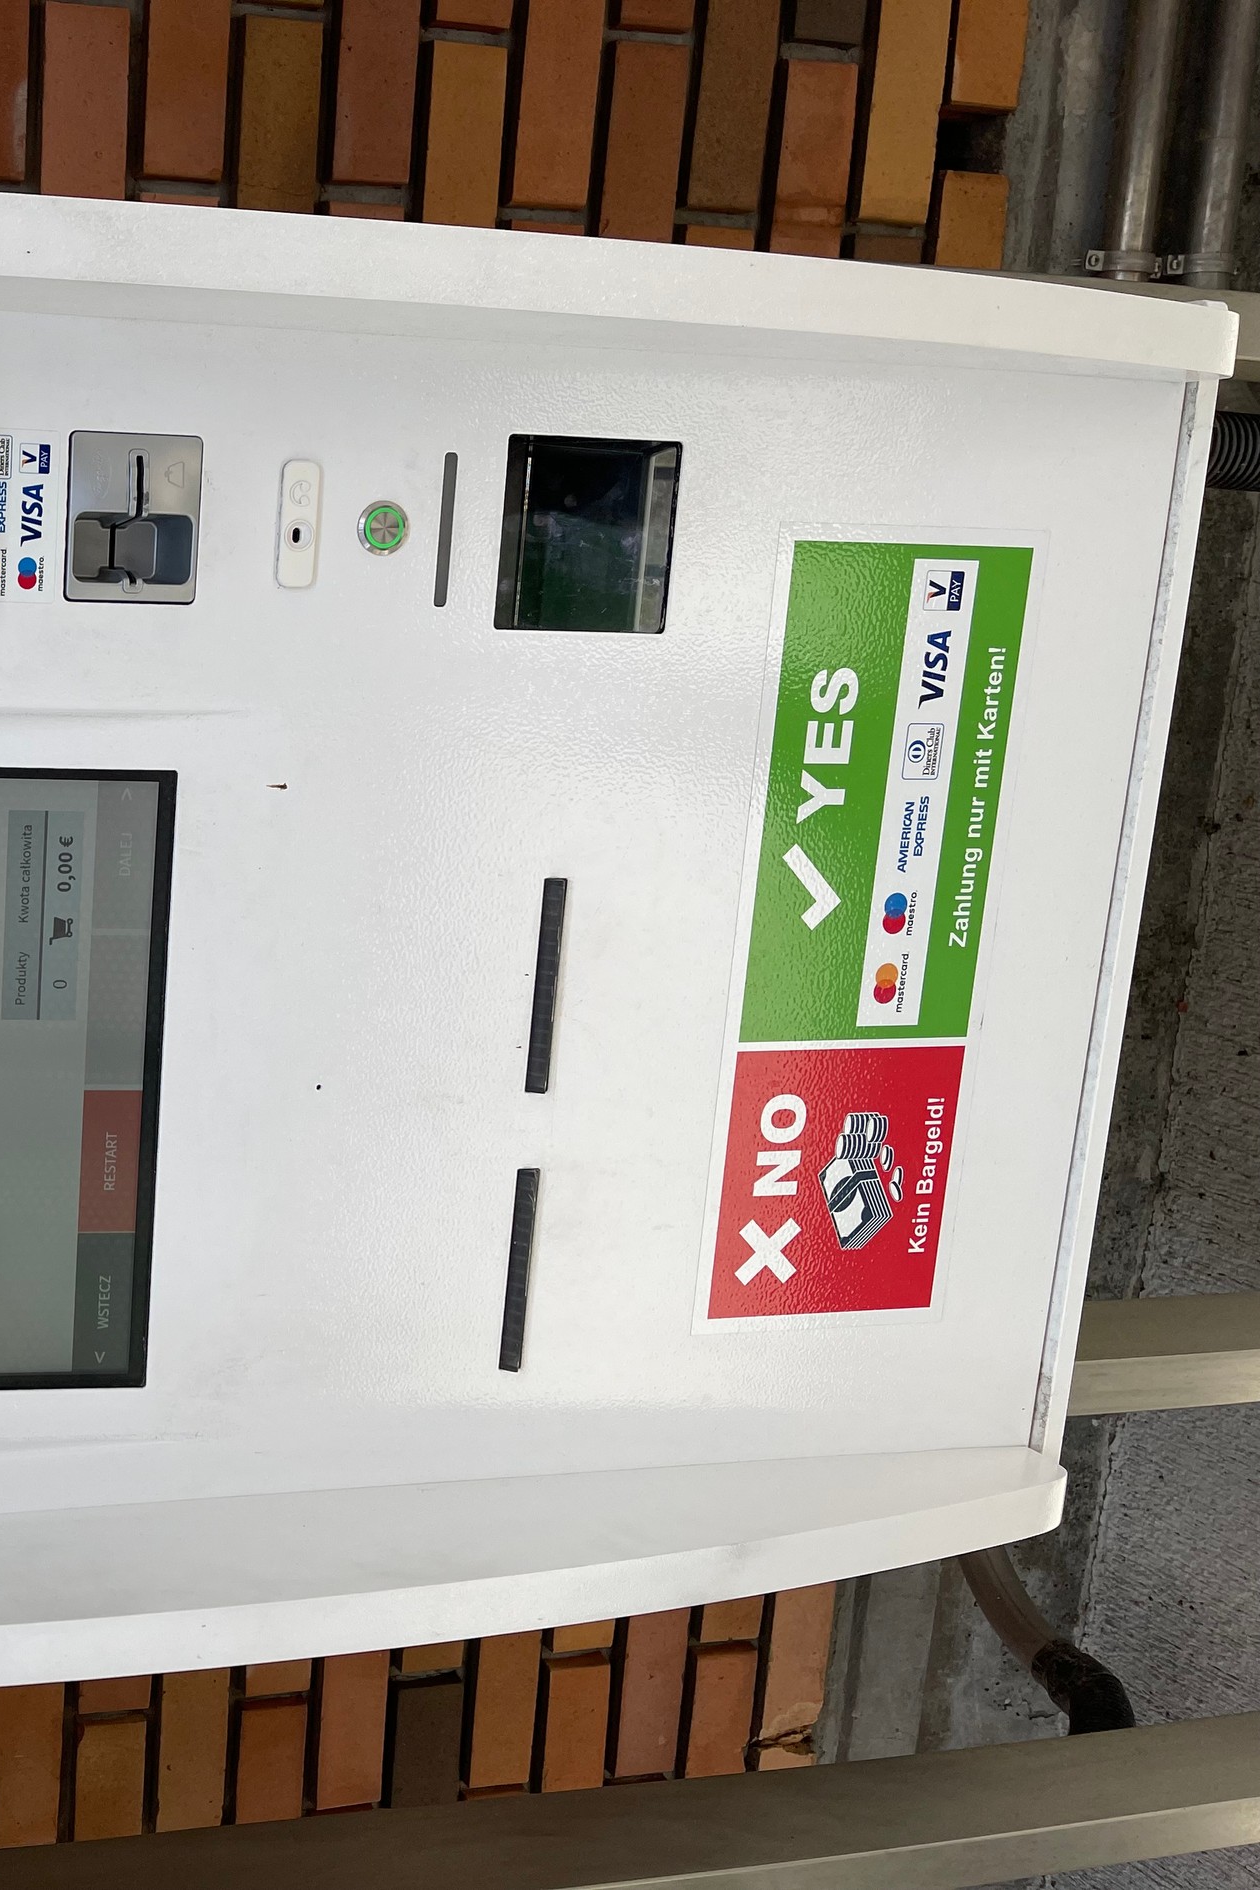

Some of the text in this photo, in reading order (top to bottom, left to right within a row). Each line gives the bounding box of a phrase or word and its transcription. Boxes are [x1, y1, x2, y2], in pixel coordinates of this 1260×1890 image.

[41, 451, 49, 468] PAY
[20, 484, 44, 547] VISA
[949, 579, 961, 602] PAY
[918, 630, 952, 709] VISA
[795, 667, 860, 824] YES
[922, 727, 936, 776] Diners Club
[931, 727, 941, 776] INTERNATIONAL
[913, 796, 930, 857] EXPRESS
[948, 646, 1007, 948] Zahlung nur mit Karten!
[57, 836, 75, 892] 0,00 €
[118, 832, 133, 876] DALEJ
[897, 801, 915, 873] AMERICAN
[18, 824, 33, 923] Kwota całkowita
[15, 951, 29, 1006] Produkty
[52, 980, 67, 989] 0
[896, 953, 909, 1012] mastercard
[104, 1132, 117, 1191] RESTART
[753, 1094, 806, 1196] NO
[908, 1097, 945, 1254] Kein Bargeld!
[97, 1275, 111, 1330] WSTECZ
